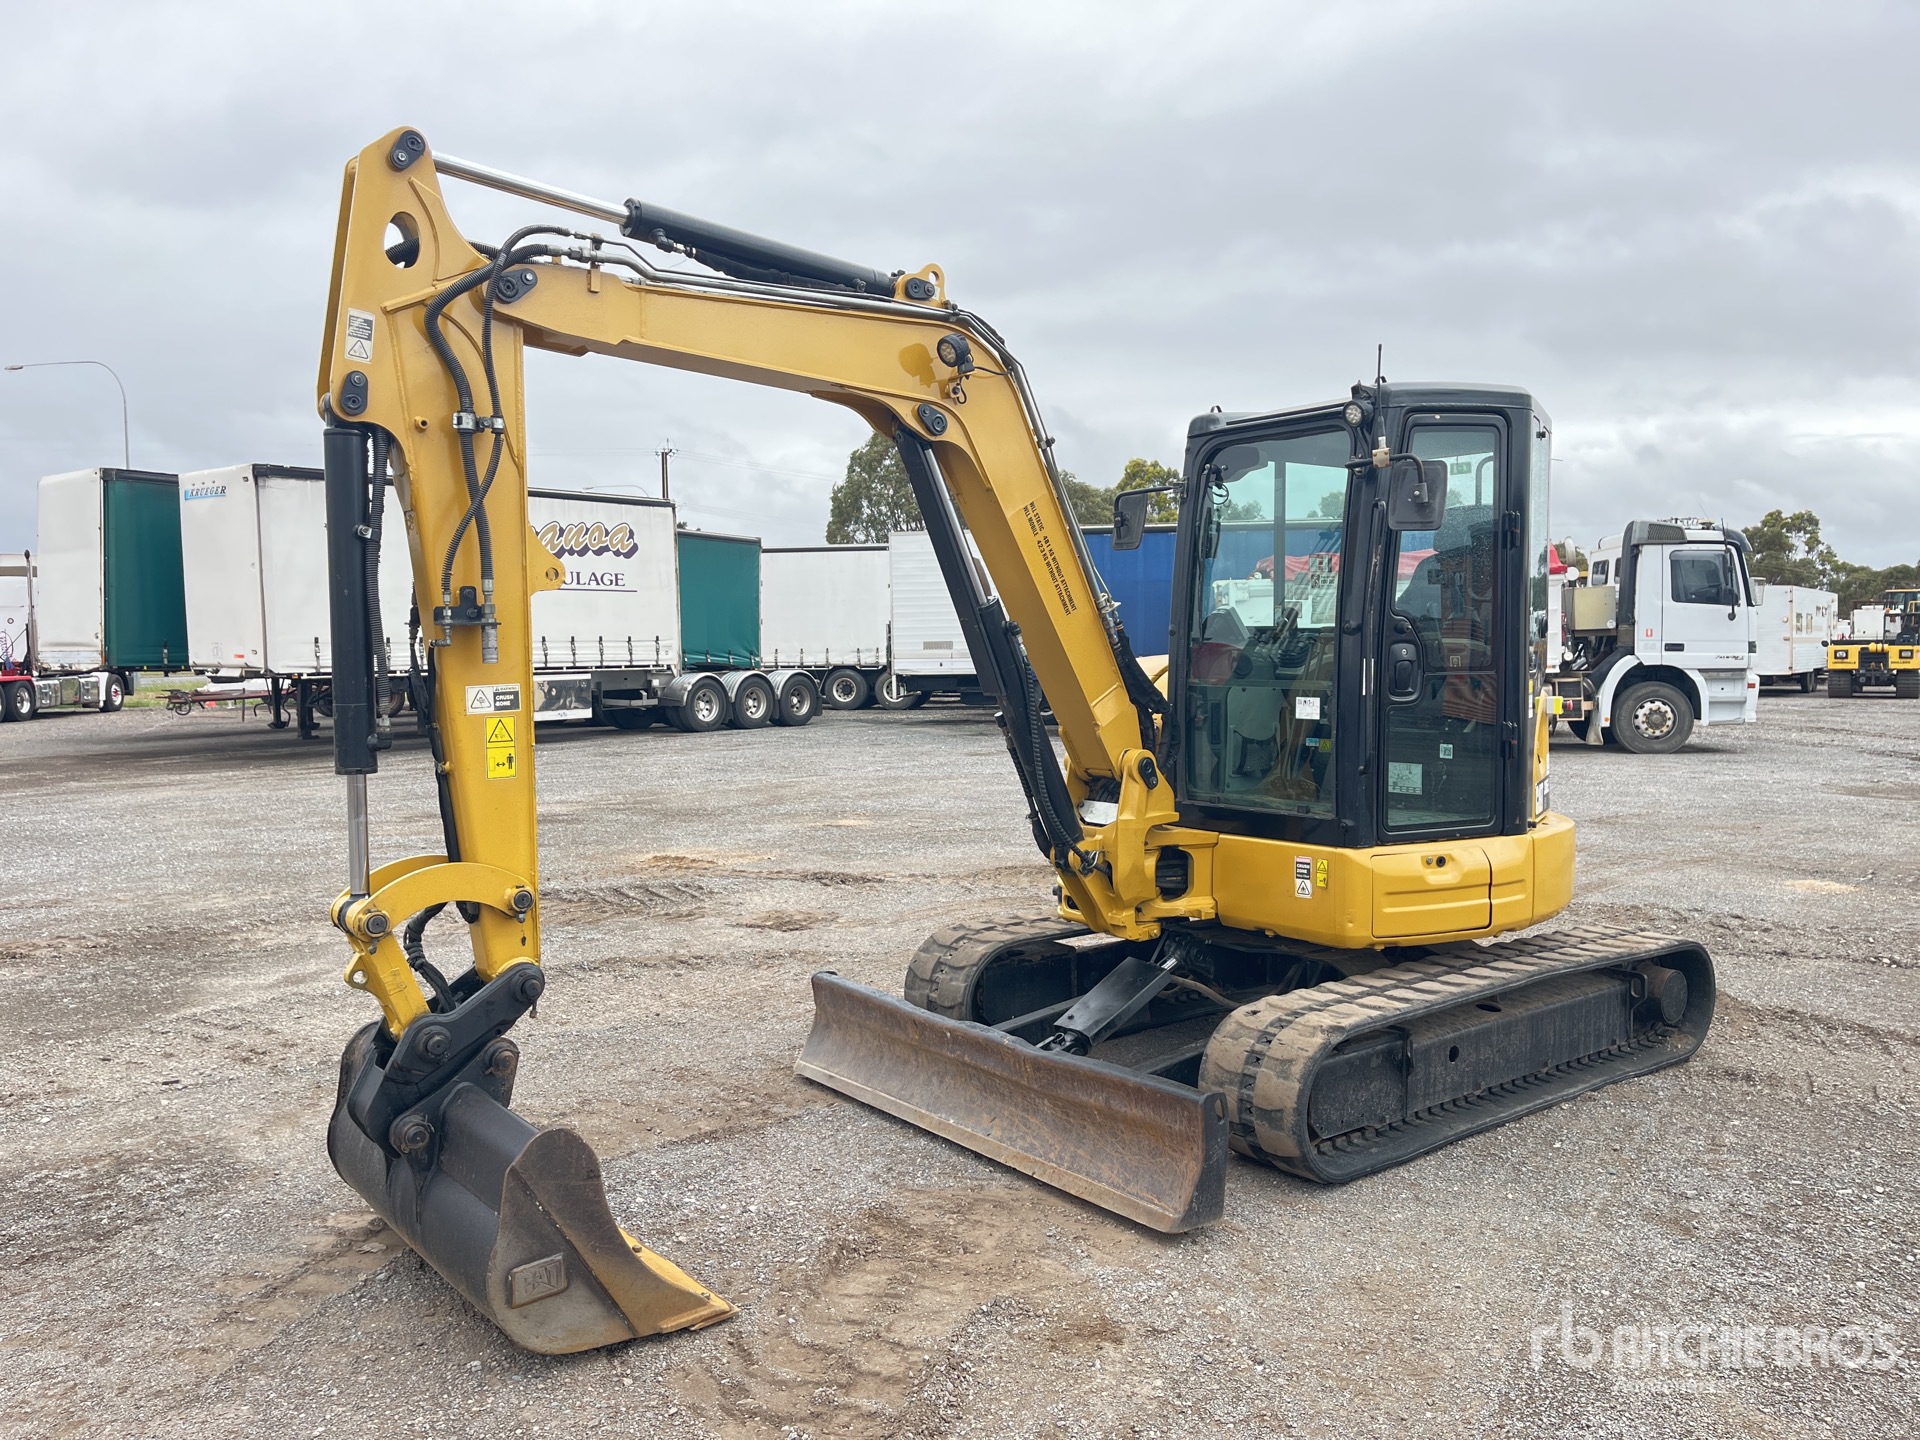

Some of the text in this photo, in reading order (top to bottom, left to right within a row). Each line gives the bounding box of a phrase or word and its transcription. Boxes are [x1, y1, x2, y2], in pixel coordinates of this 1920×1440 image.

[190, 486, 226, 497] KRUEGER
[532, 520, 639, 559] anoa
[563, 571, 626, 586] ULAGE
[1028, 517, 1039, 537] MOBILE
[1037, 540, 1046, 553] 423
[1046, 560, 1058, 584] WITHOUT
[1055, 583, 1071, 616] ATTACHMENT
[1034, 512, 1044, 532] STATIC
[1043, 535, 1051, 548] 481
[1052, 556, 1064, 579] WITHOUT
[1060, 578, 1077, 611] ATTACHMENT
